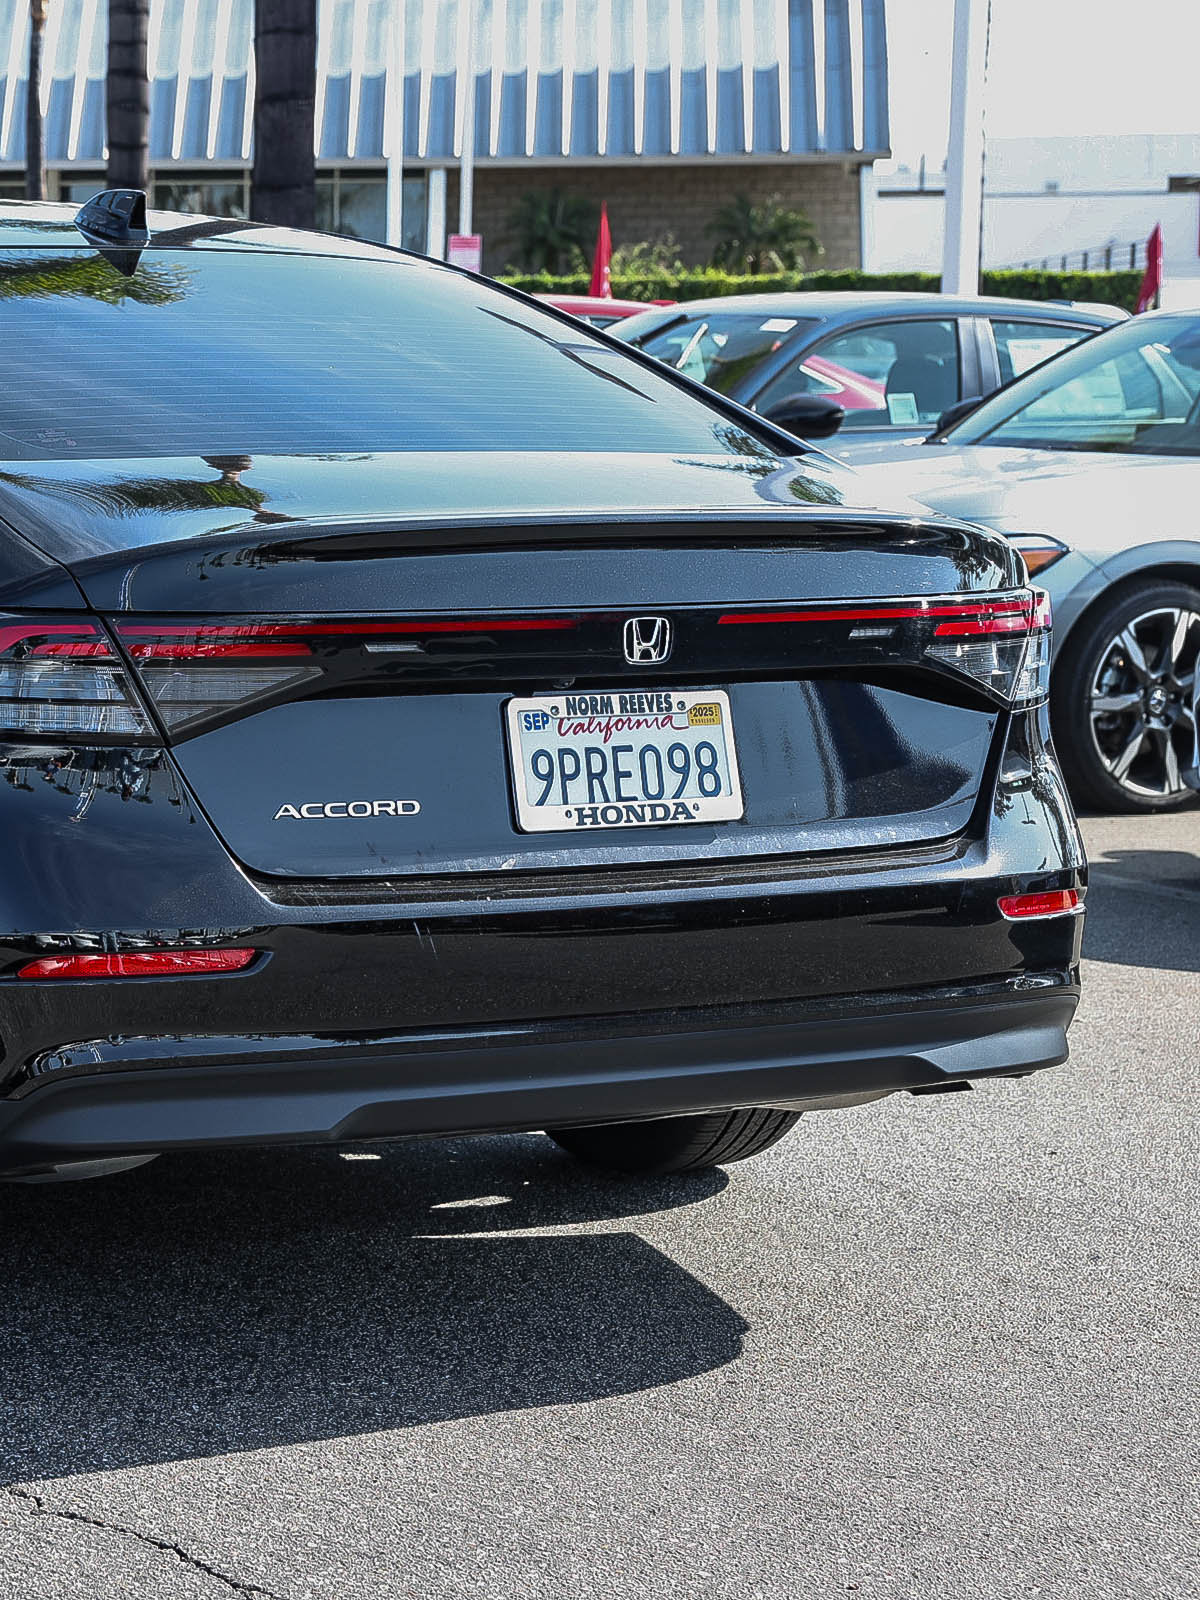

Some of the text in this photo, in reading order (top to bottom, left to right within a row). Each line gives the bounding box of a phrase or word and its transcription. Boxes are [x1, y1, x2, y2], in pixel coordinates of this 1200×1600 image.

[565, 693, 673, 716] NORM REEVES
[692, 706, 714, 717] 2025
[523, 711, 550, 731] SEP
[557, 714, 689, 744] California
[530, 740, 722, 806] 9PRE098
[273, 799, 421, 820] ACCORD
[574, 802, 697, 826] HONDA
